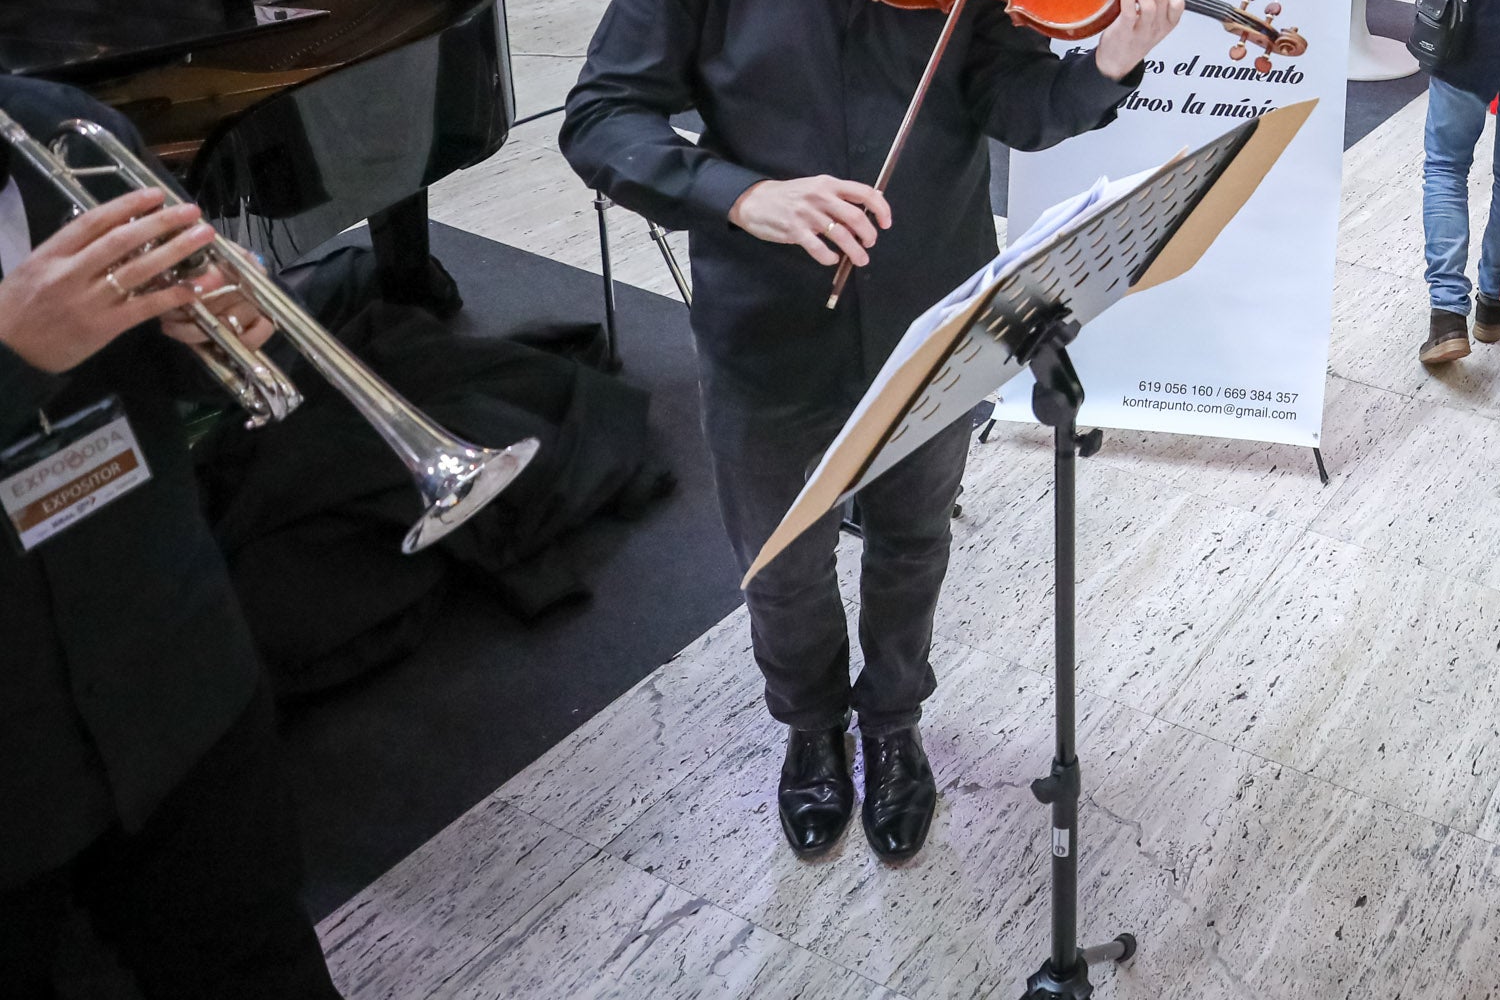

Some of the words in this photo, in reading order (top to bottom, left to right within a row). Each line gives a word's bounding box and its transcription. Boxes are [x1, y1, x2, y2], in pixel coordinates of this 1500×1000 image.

[1173, 55, 1200, 77] el
[1200, 64, 1304, 85] momento
[1181, 92, 1205, 115] la
[1210, 98, 1278, 119] músi
[1138, 380, 1161, 393] 619
[1164, 382, 1187, 395] 056
[1192, 385, 1213, 398] 160
[1216, 386, 1221, 398] /
[1224, 387, 1247, 400] 669
[1250, 389, 1272, 402] 384
[1275, 391, 1299, 404] 357
[1122, 396, 1297, 420] kontrapunto.com@gmail.com
[42, 460, 122, 514] EXPOSITOR
